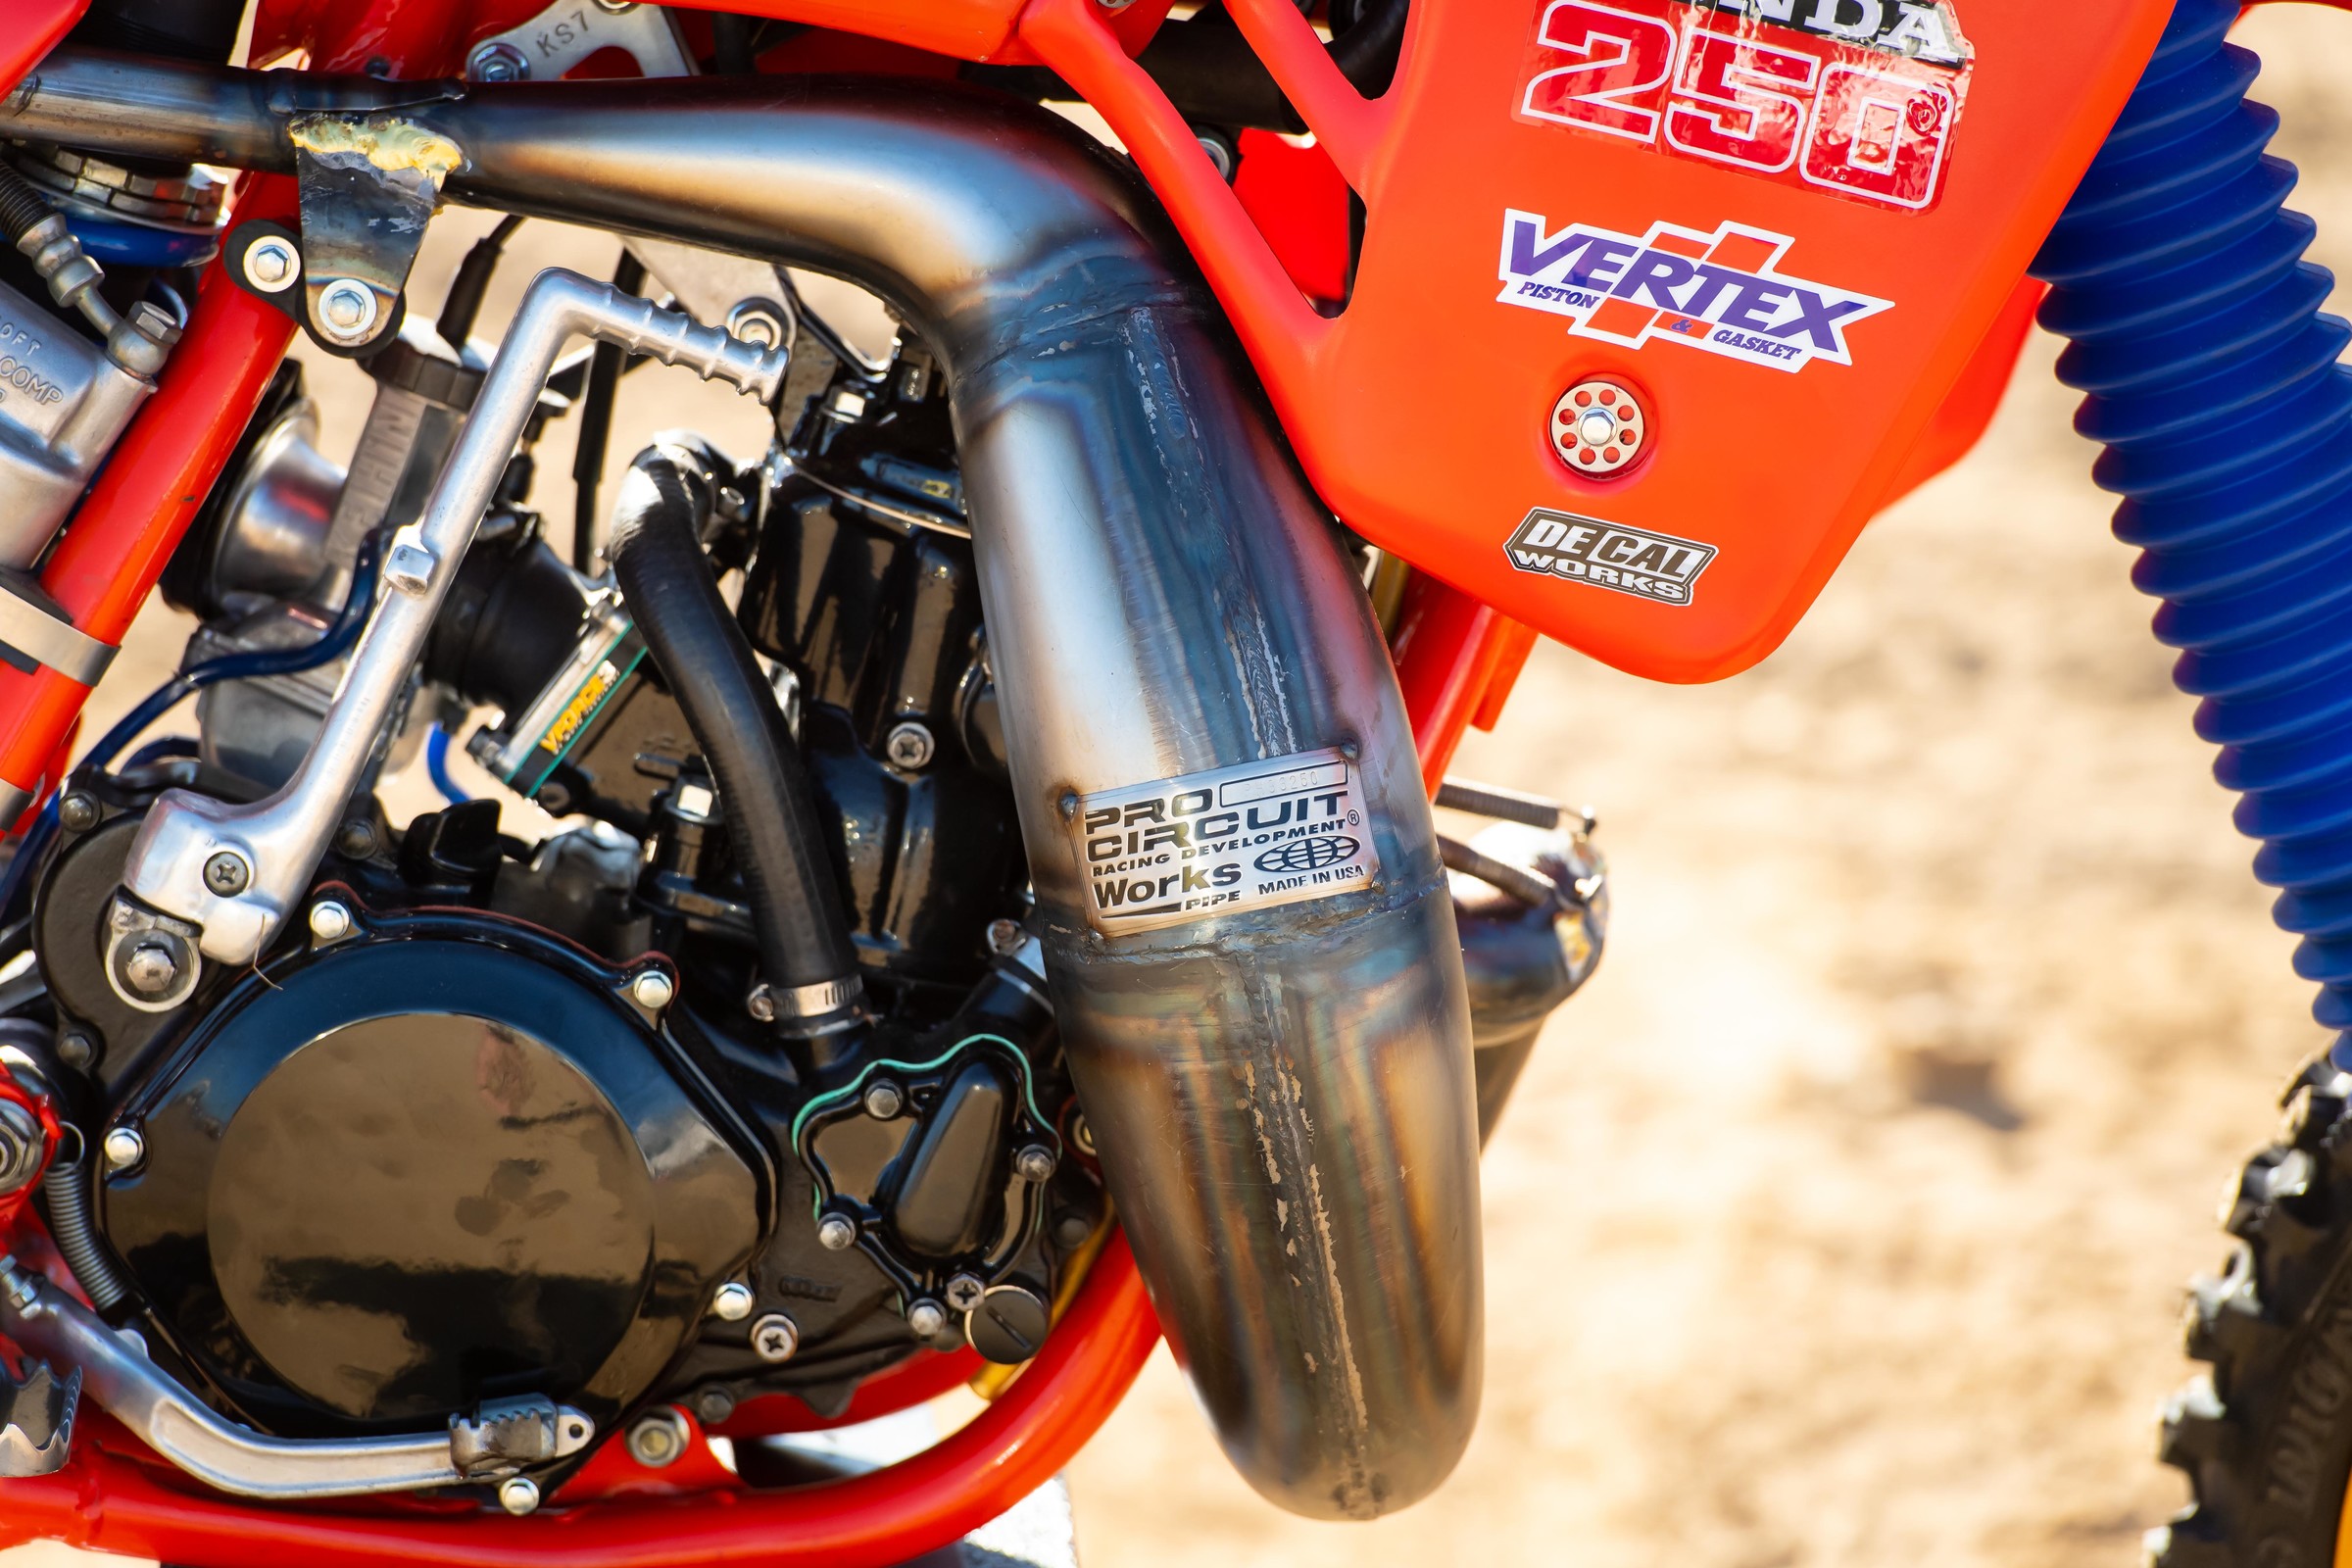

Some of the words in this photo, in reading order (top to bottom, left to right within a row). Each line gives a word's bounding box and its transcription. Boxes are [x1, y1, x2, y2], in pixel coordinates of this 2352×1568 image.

[1520, 0, 1955, 210] 250
[1509, 220, 1869, 353] VERTEX
[0, 321, 42, 357] OFT
[1517, 281, 1600, 309] PISTON
[1670, 318, 1693, 333] &
[1713, 329, 1802, 360] GASKET
[0, 356, 64, 405] COMP
[1522, 518, 1695, 579] DECAL
[1513, 549, 1684, 600] WORKS
[1084, 788, 1213, 835] PRO
[1087, 790, 1348, 862] CIRCUIT
[1093, 854, 1170, 877] RACING
[1181, 818, 1346, 860] DEVELOPMENT
[1093, 862, 1242, 909] Works
[1185, 890, 1241, 911] PIPE
[1258, 875, 1307, 896] MADE
[1312, 870, 1331, 884] IN
[1335, 865, 1364, 880] USA
